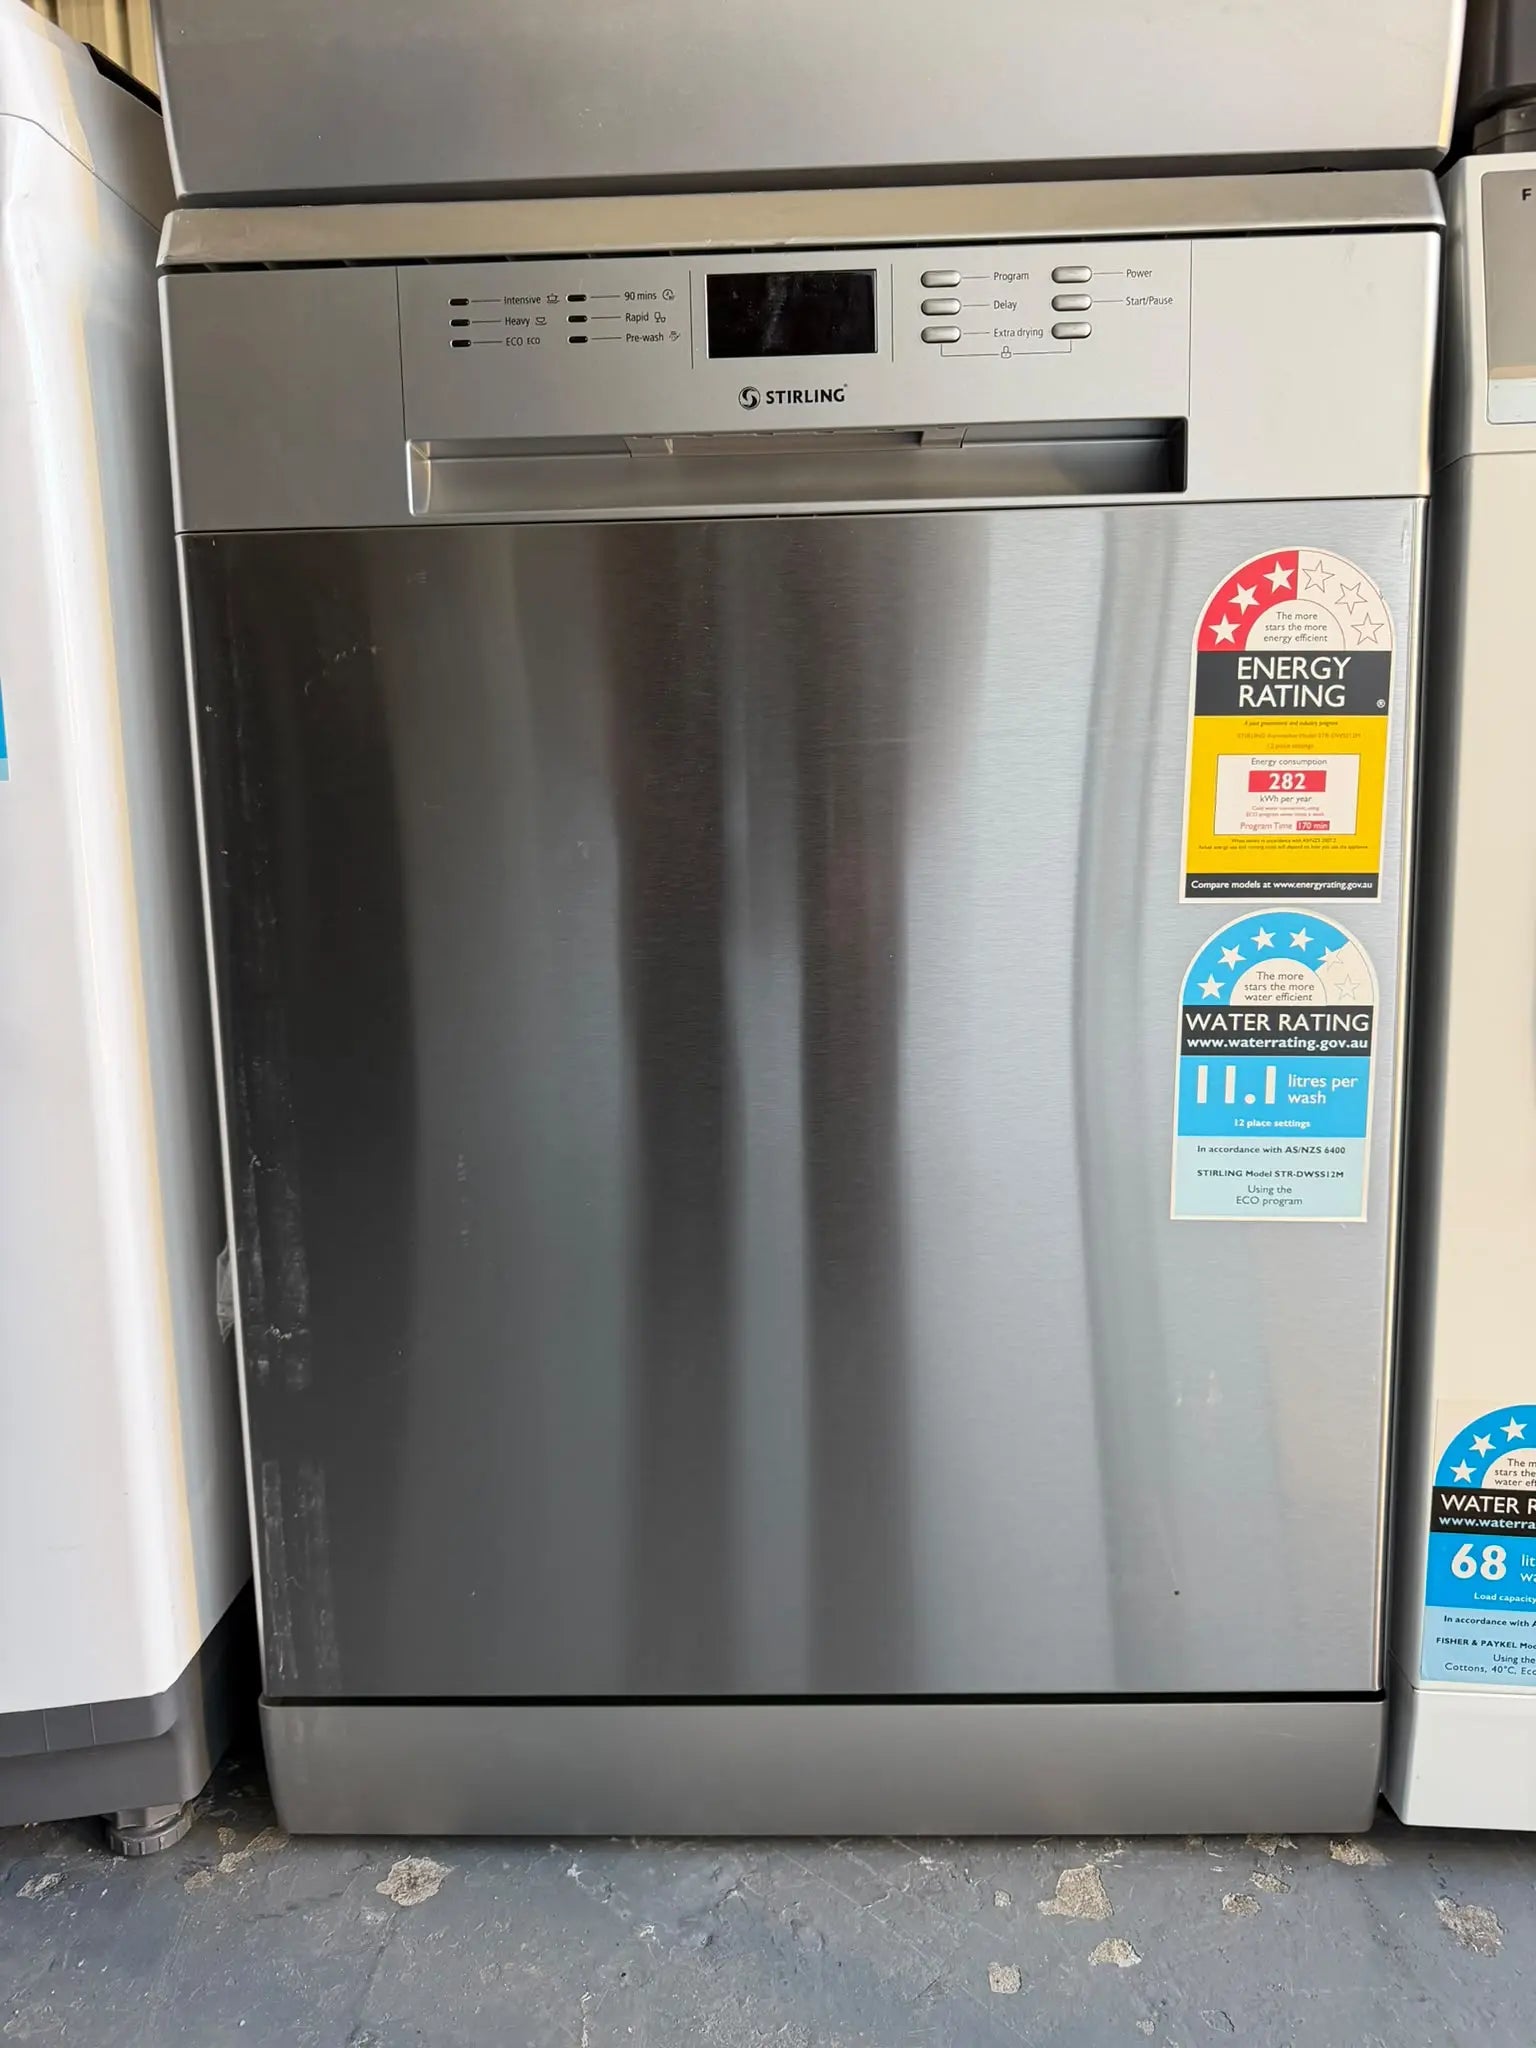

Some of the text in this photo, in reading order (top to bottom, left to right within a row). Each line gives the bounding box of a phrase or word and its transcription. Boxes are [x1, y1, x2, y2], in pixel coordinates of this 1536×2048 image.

[993, 271, 1030, 282] Program
[1126, 268, 1153, 278] Power
[504, 296, 541, 305] Intensive
[624, 290, 658, 301] 90 mins
[993, 299, 1018, 311] Delay
[1126, 296, 1174, 307] Start/Pause
[505, 316, 530, 327] Heavy
[625, 311, 649, 324] Rapid
[626, 331, 664, 342] Pre-wash
[993, 327, 1044, 339] Extra drying
[506, 337, 524, 346] ECO
[766, 388, 846, 404] STIRLING
[1276, 611, 1319, 620] The more
[1265, 623, 1285, 631] stars
[1288, 622, 1303, 631] the
[1263, 633, 1328, 644] energy efficient
[1237, 656, 1352, 680] ENERGY
[1238, 684, 1346, 708] RATING
[1250, 757, 1328, 767] Energy consumption
[1268, 772, 1306, 790] 282
[1260, 794, 1312, 805] kWh per year
[1240, 821, 1328, 831] Program Time 170 min
[1191, 880, 1373, 892] Compare models at www.energyrating.gov.au
[1256, 971, 1304, 981] The more
[1244, 981, 1315, 991] stars the more
[1244, 991, 1313, 1002] water efficient
[1185, 1013, 1370, 1033] WATER RATING
[1186, 1036, 1368, 1051] www.waterrating.gov.au
[1196, 1064, 1277, 1105] 11.1
[1288, 1073, 1359, 1092] litres per
[1287, 1091, 1327, 1105] wash
[1234, 1118, 1312, 1129] 12 place settings
[1197, 1145, 1346, 1154] In accordance with AS/NZS 6400
[1196, 1169, 1344, 1178] STIRLING Model STR-DWSS12M
[1247, 1184, 1292, 1195] Using the
[1236, 1195, 1303, 1207] ECO program
[1507, 1458, 1526, 1468] The
[1494, 1468, 1518, 1477] stars
[1494, 1478, 1523, 1487] water
[1440, 1493, 1520, 1515] WATER
[1438, 1516, 1536, 1530] www.waterra
[1451, 1543, 1507, 1581] 68
[1473, 1592, 1536, 1605] Load capacity
[1454, 1617, 1507, 1626] accordance
[1509, 1618, 1530, 1627] with
[1436, 1637, 1469, 1646] FISHER
[1480, 1639, 1517, 1649] PAYKEL
[1493, 1653, 1536, 1665] Using the
[1444, 1661, 1488, 1674] Cottons,
